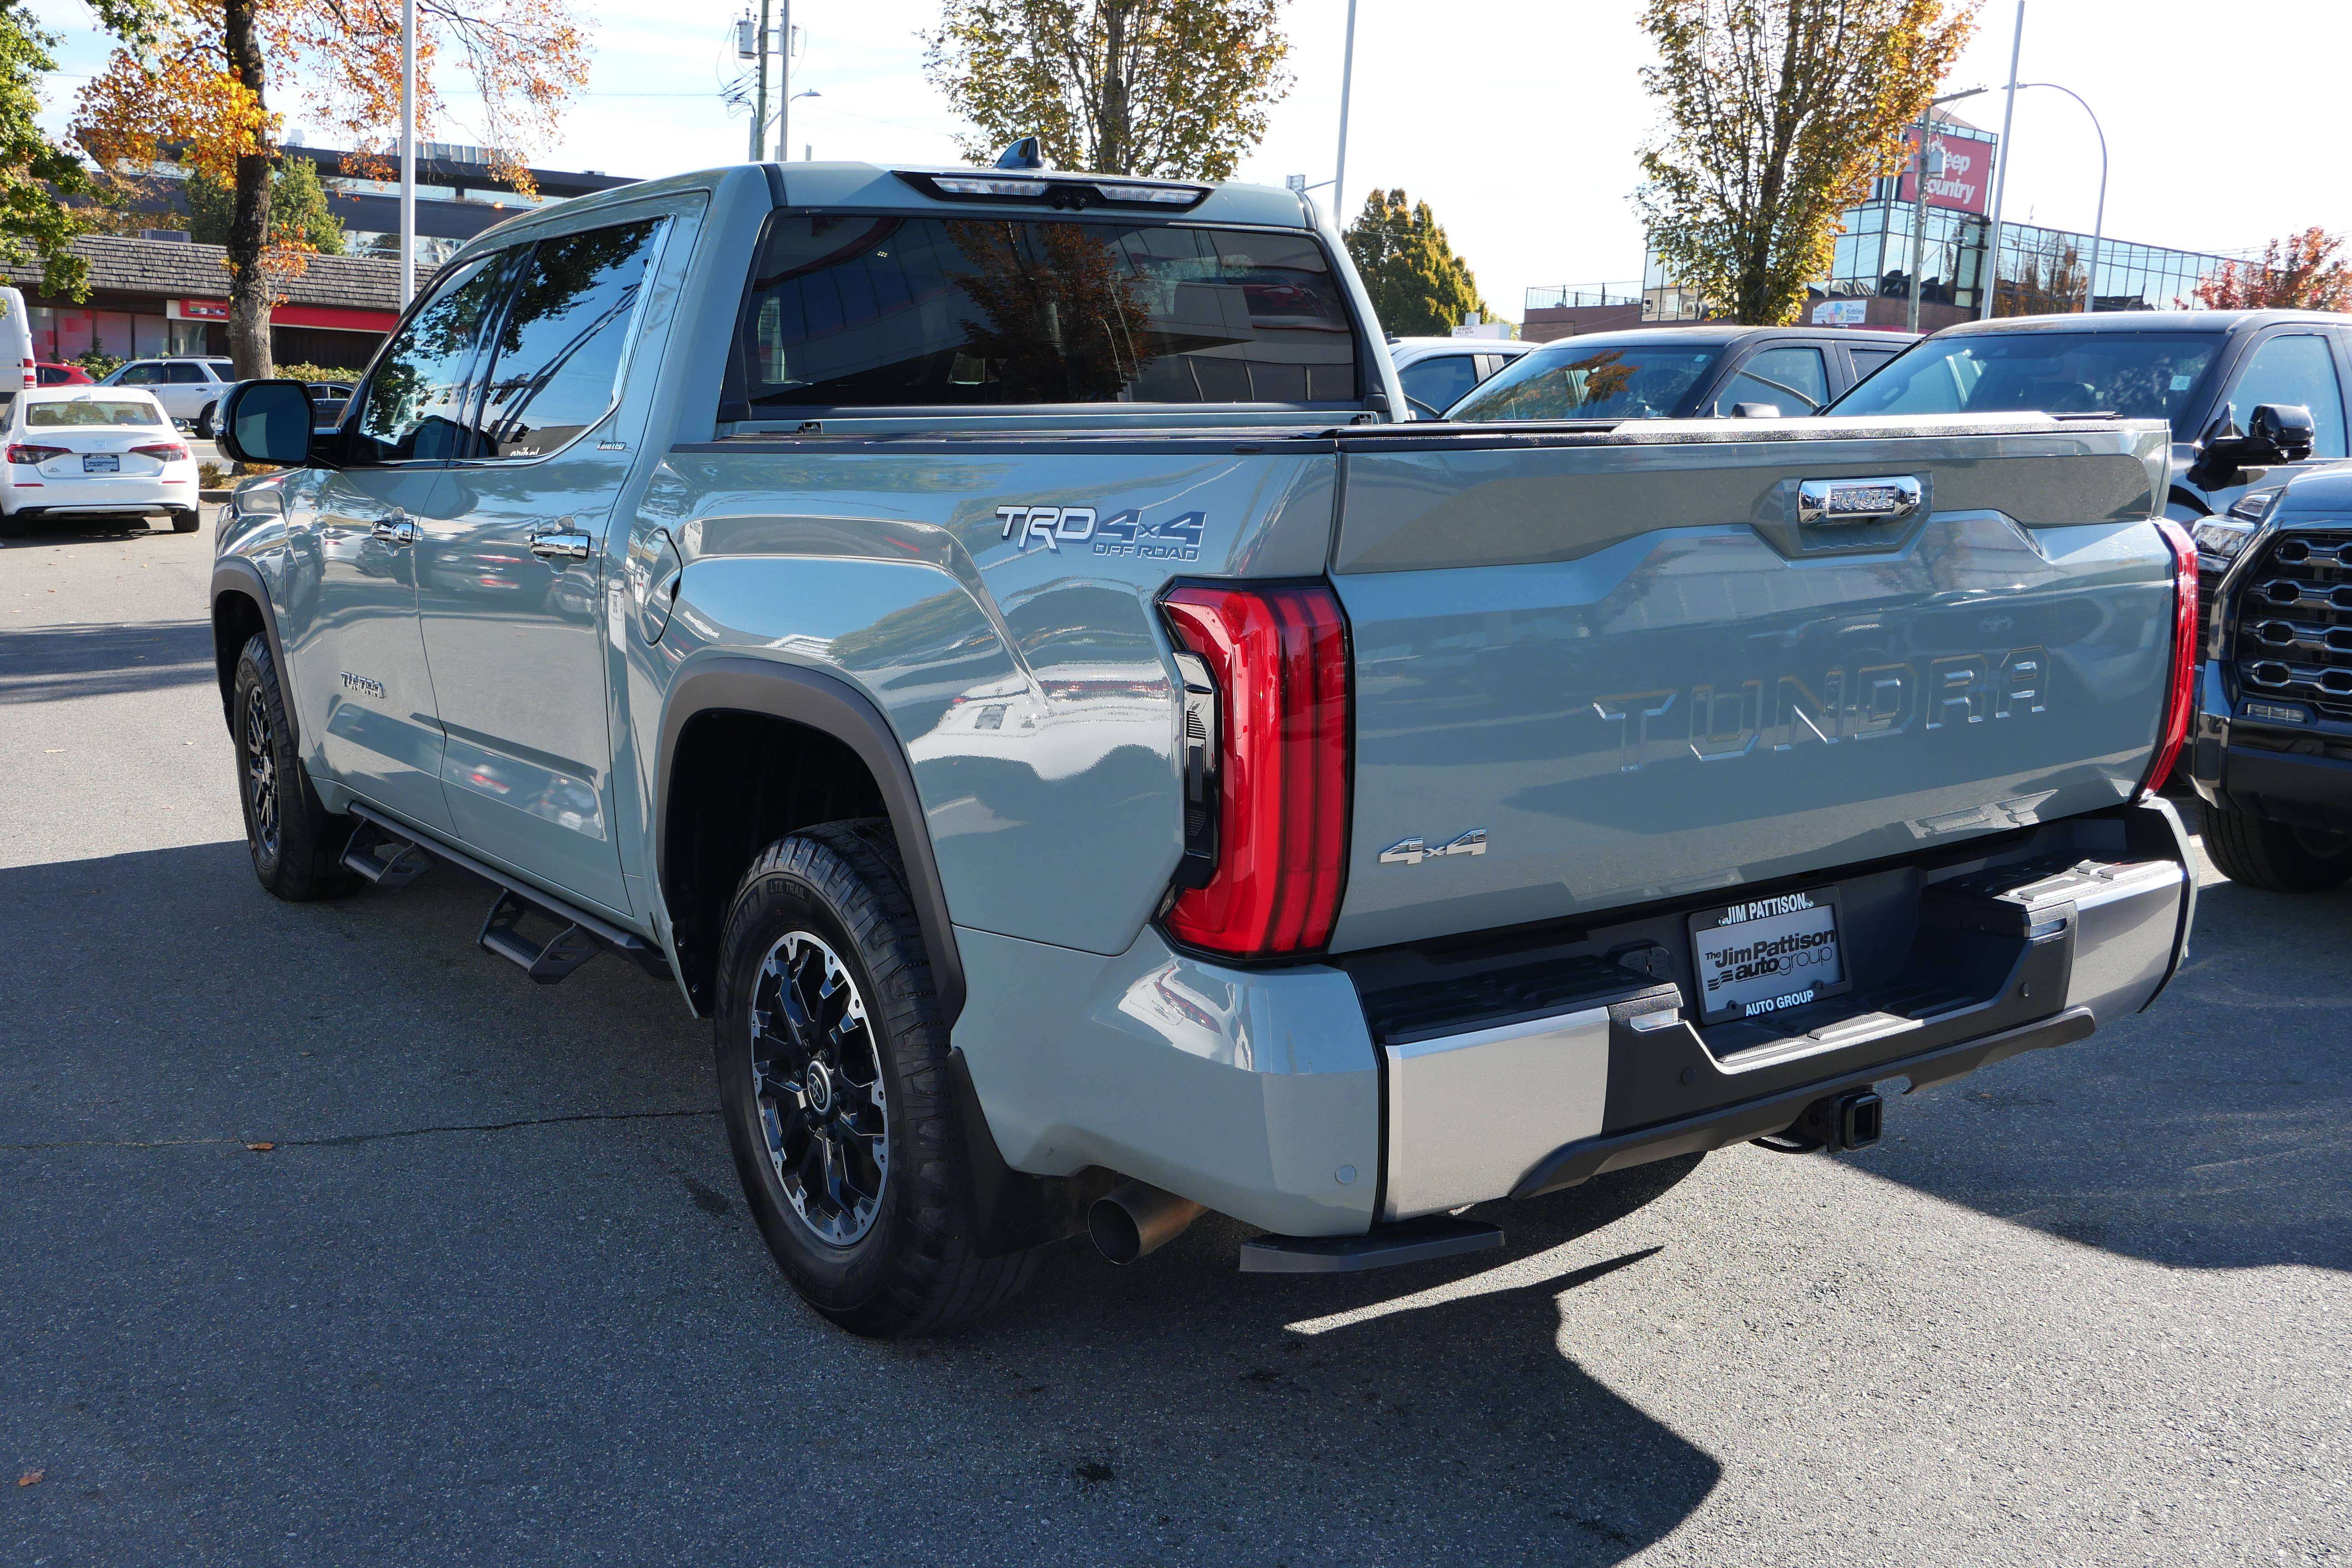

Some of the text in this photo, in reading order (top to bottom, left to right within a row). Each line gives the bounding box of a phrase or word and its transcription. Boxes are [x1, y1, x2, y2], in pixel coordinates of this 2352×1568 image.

[1834, 490, 1890, 509] TOYOTA
[995, 505, 1098, 556] TRD
[1093, 542, 1200, 562] OFF ROAD
[1592, 645, 2051, 773] TUNDRA
[769, 880, 806, 901] LTX TRAIL
[1726, 892, 1806, 926] JIM PATTISON
[1705, 951, 1721, 960] The
[1745, 990, 1814, 1017] AUTO GROUP
